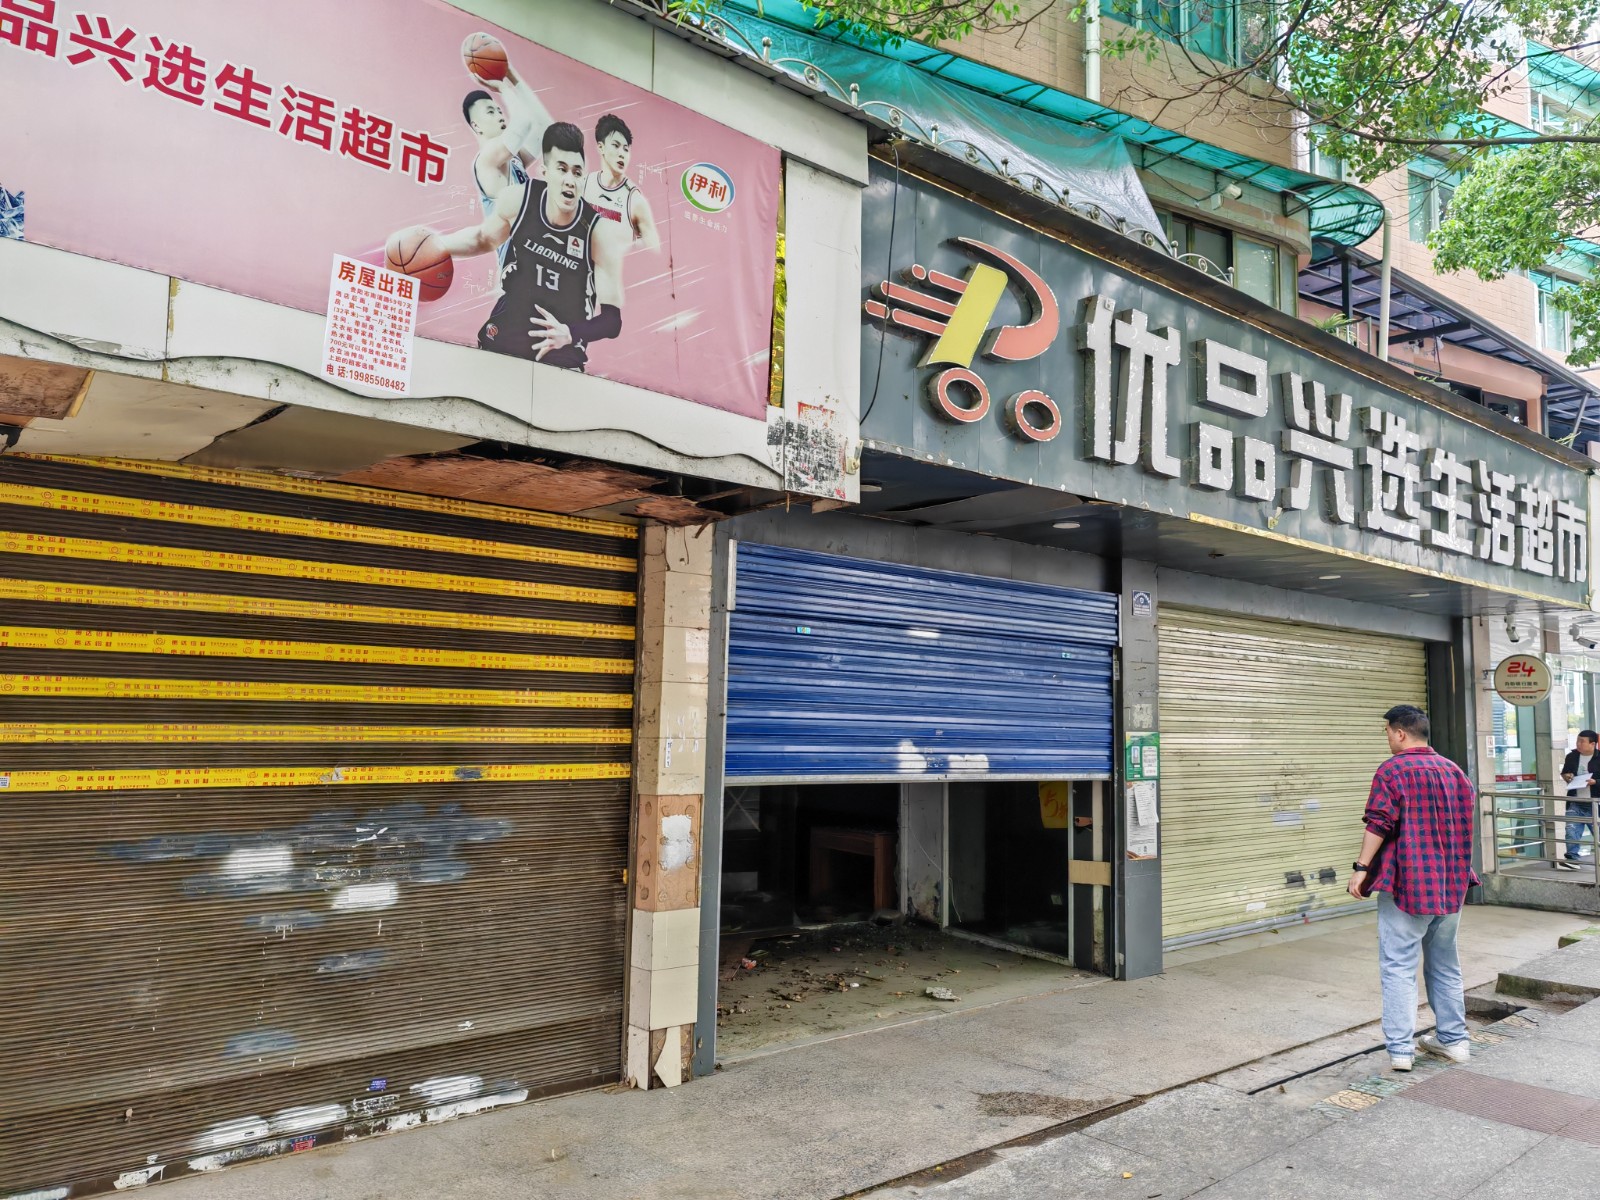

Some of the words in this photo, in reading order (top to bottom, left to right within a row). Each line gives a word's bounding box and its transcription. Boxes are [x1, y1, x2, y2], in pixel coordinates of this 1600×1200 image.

[689, 172, 727, 203] 伊利
[523, 238, 580, 271] LIAONING
[338, 261, 413, 300] 房屋出租
[536, 263, 561, 291] 13
[1085, 293, 1587, 583] 优品兴选生活超市
[1507, 661, 1536, 678] 24
